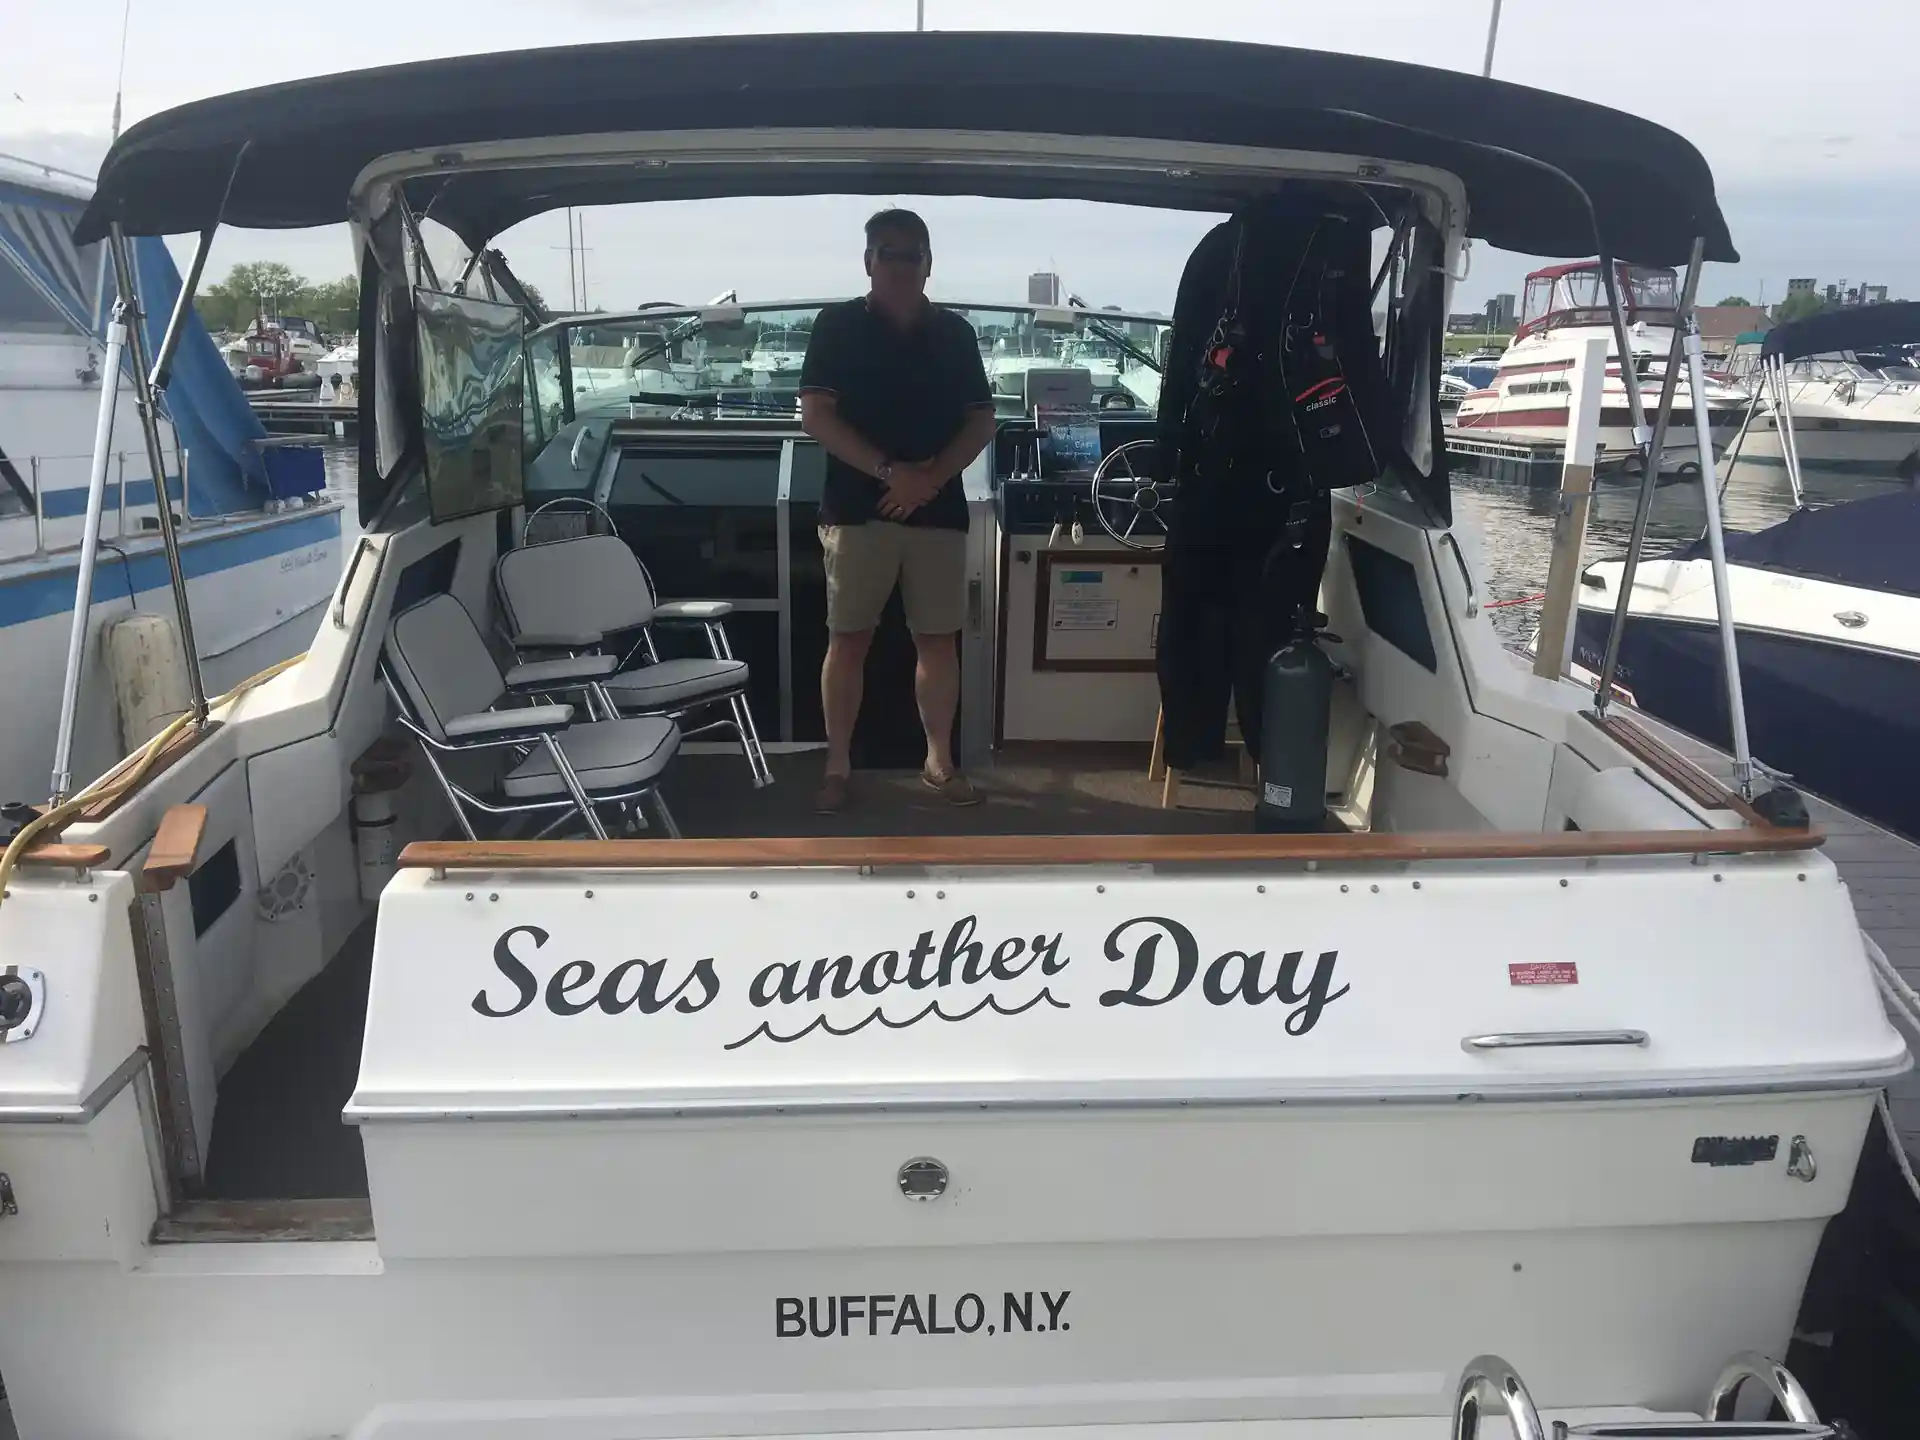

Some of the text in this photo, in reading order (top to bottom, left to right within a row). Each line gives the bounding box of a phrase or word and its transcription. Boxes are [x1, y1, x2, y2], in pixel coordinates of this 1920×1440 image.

[1306, 396, 1337, 412] classic
[472, 914, 1351, 1037] Seas another Day
